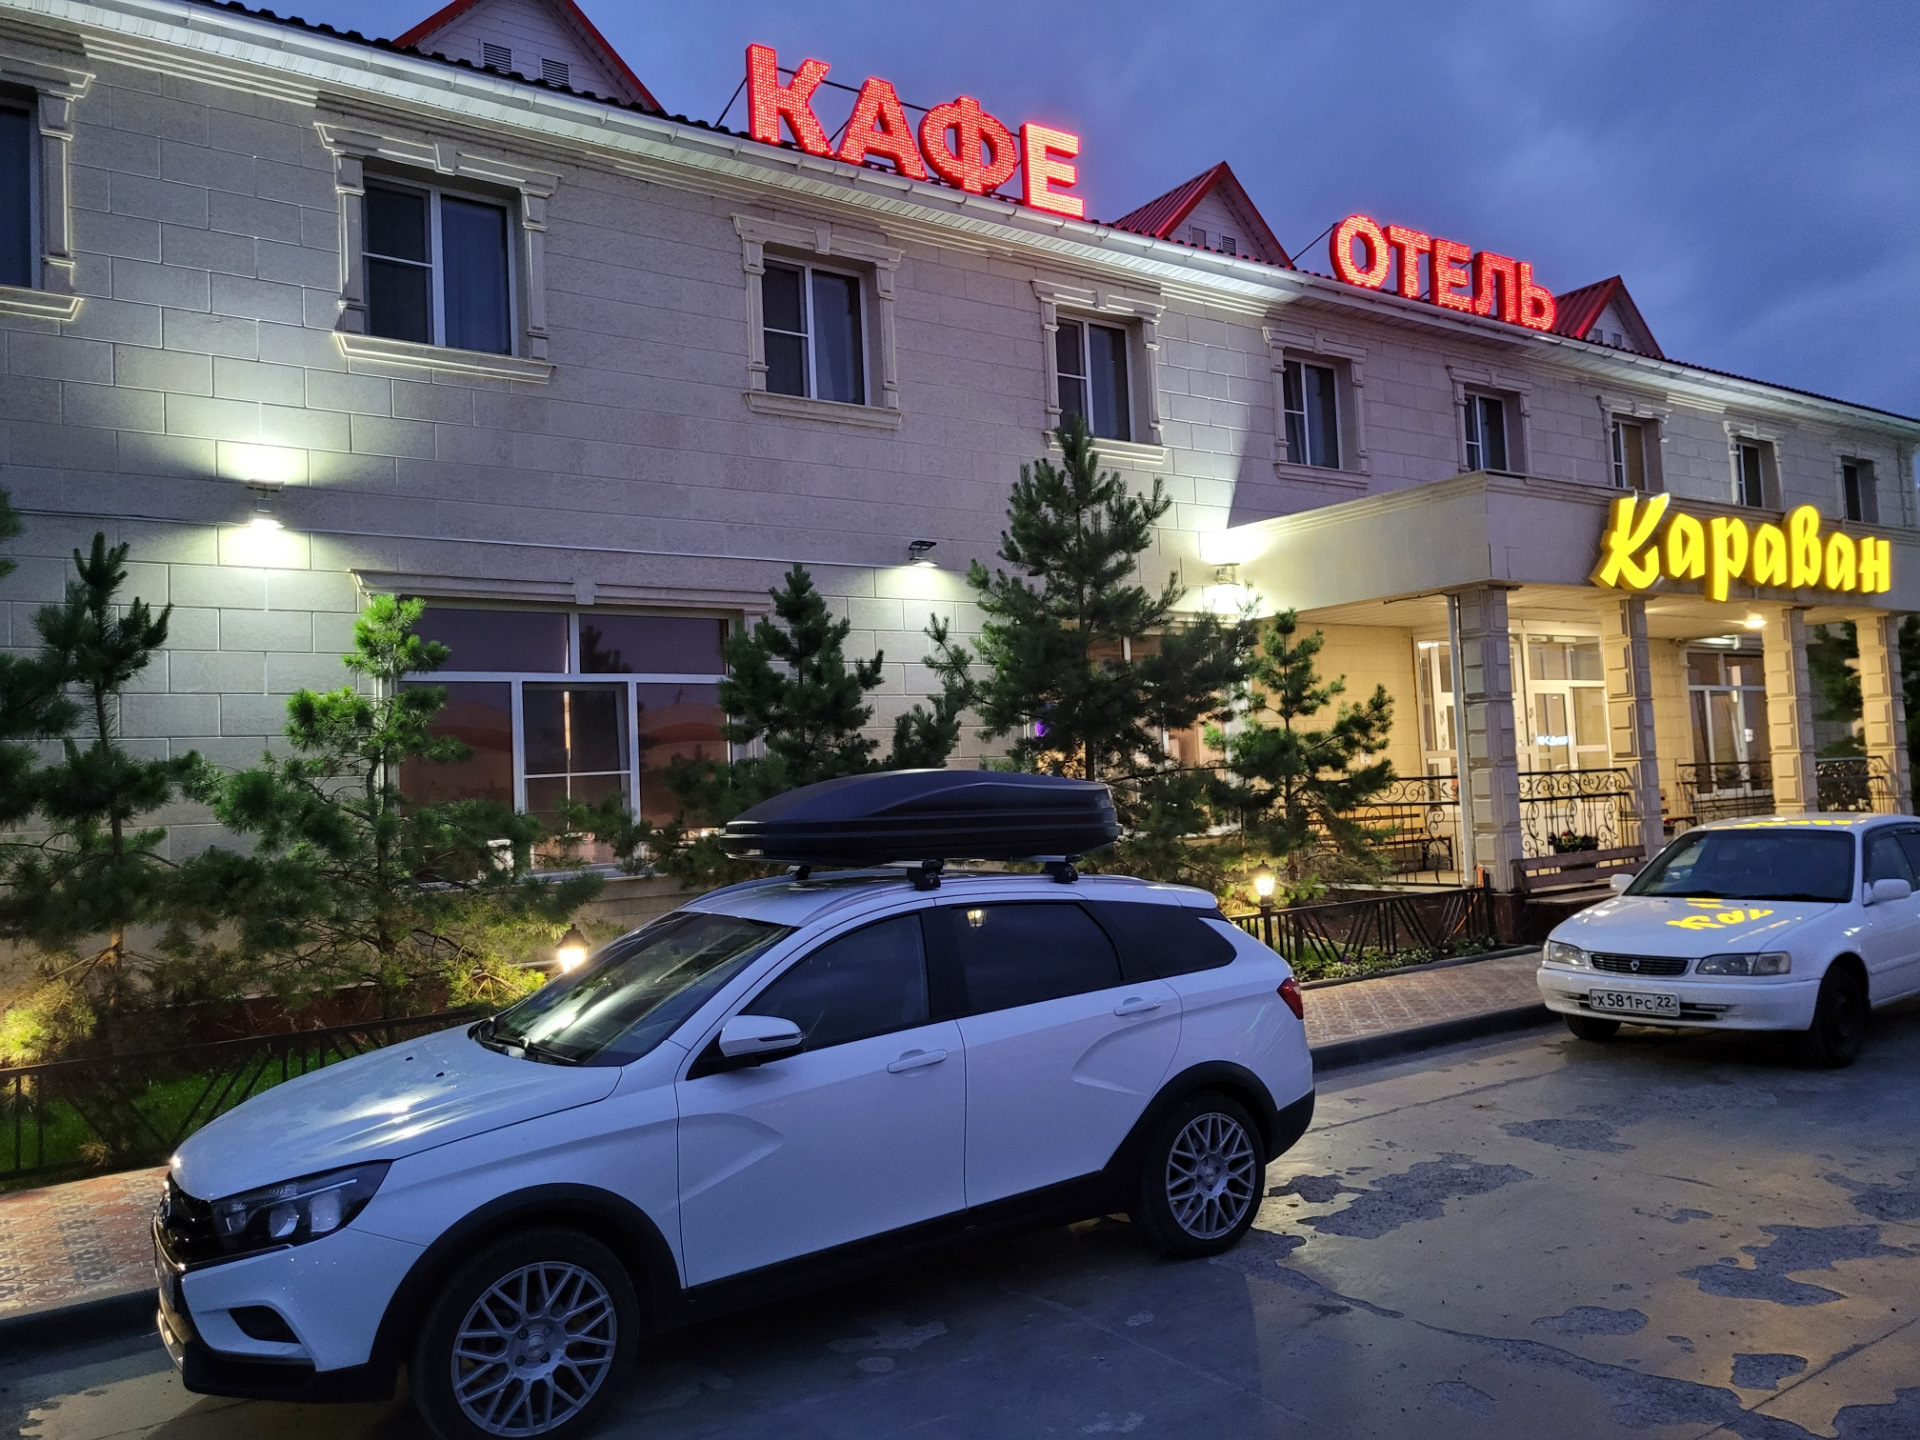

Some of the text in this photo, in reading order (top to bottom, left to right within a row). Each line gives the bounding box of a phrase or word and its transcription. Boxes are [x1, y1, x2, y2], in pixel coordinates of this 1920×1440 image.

[746, 43, 1084, 219] КАФЕ
[1329, 214, 1557, 331] ОТЕЛЬ
[1597, 493, 1890, 602] Караван
